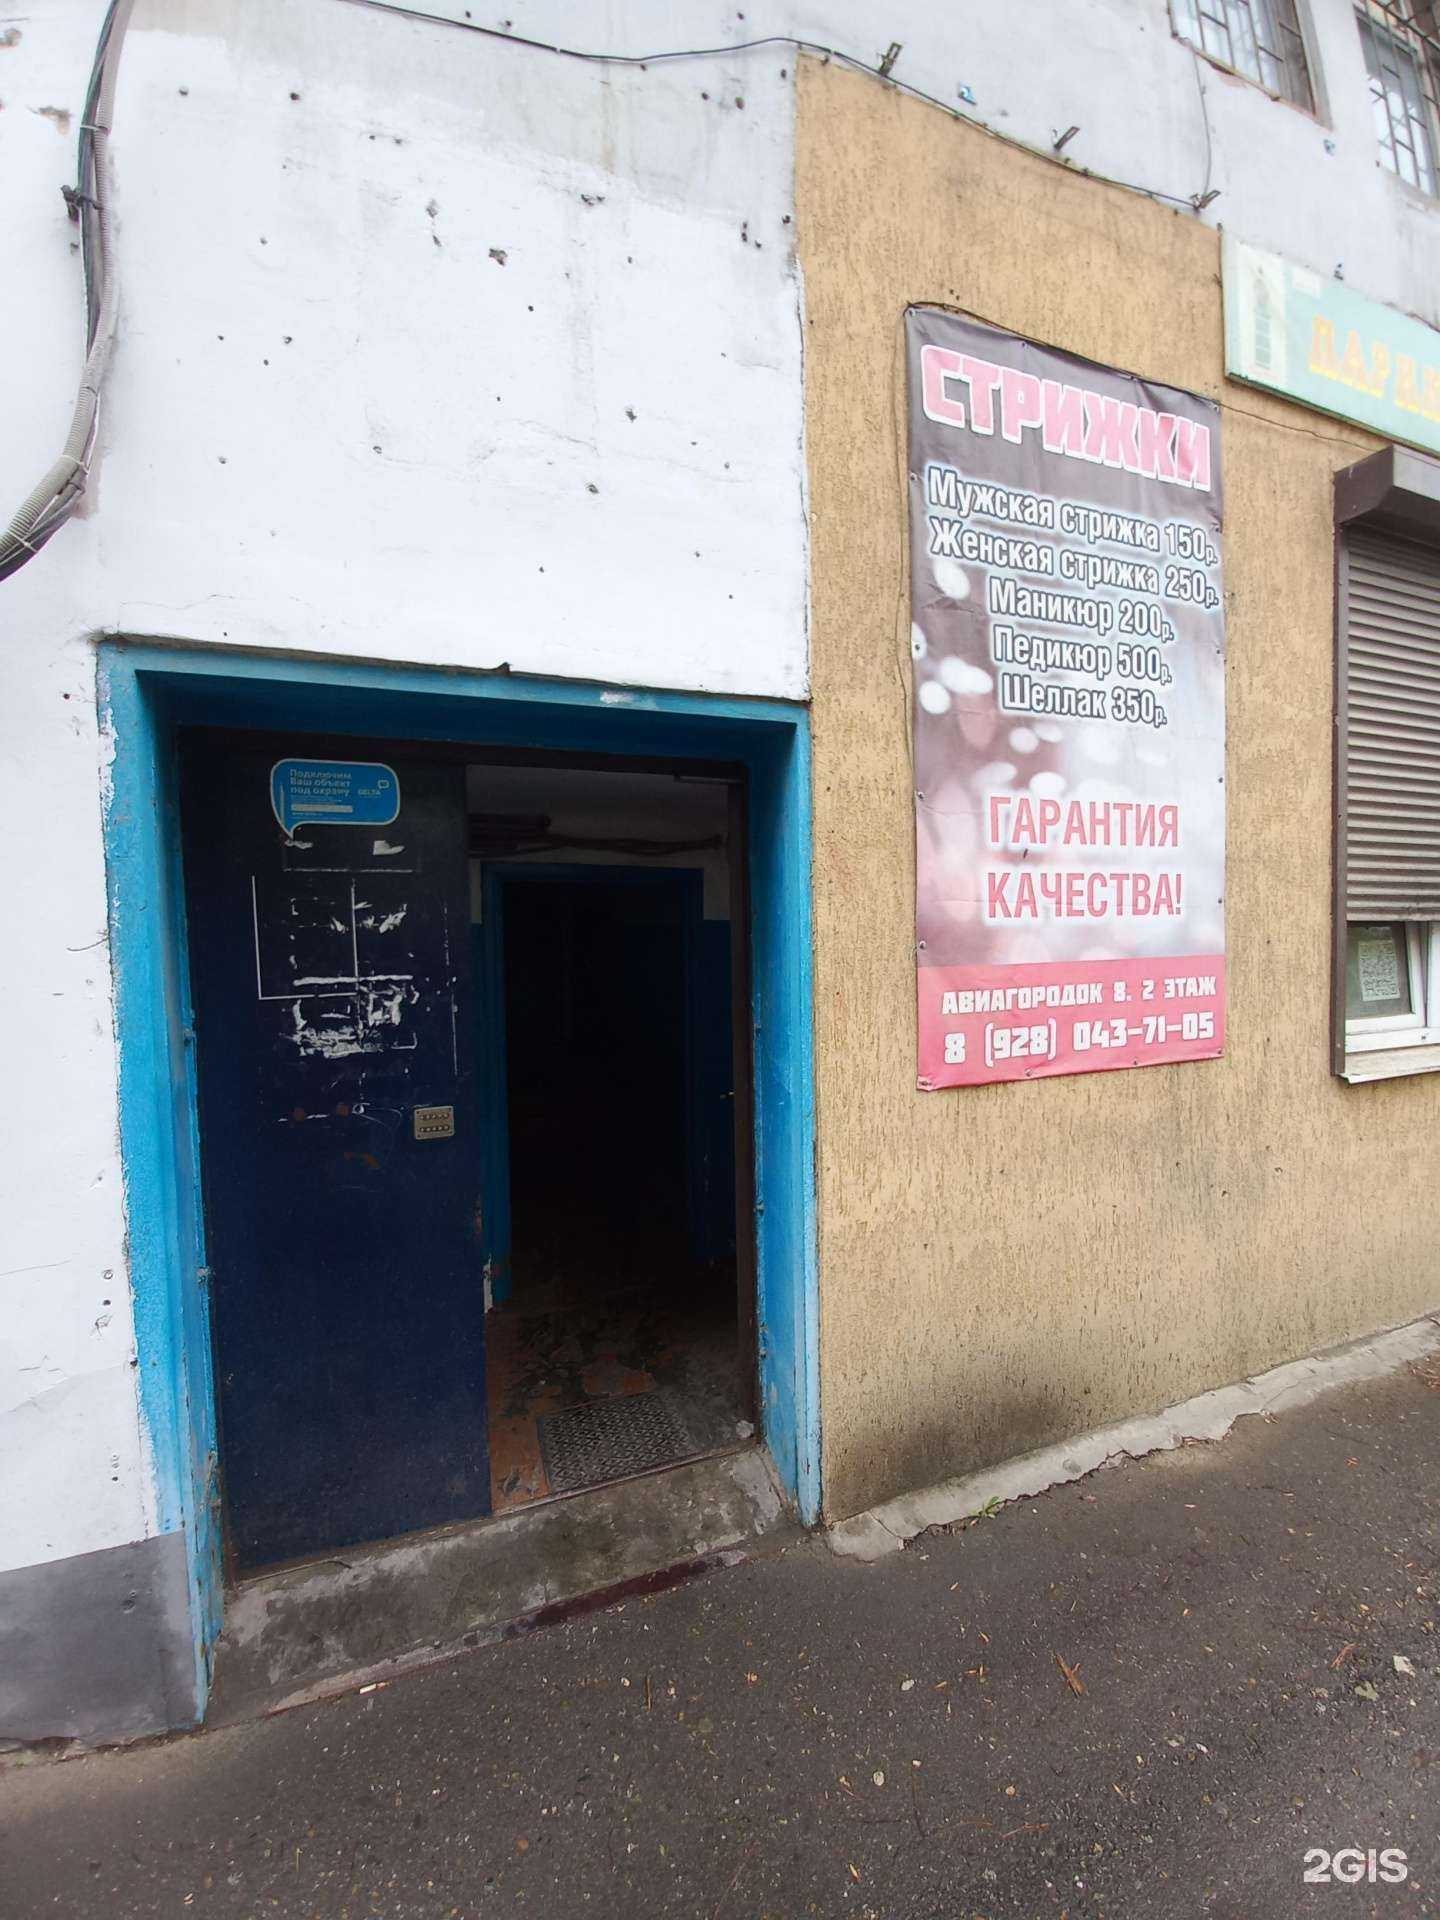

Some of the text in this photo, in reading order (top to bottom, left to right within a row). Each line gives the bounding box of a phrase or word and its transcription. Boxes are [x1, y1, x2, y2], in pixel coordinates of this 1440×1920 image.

[921, 344, 1211, 492] СТРИЖКИ
[929, 467, 1218, 565] Мужская стрижка 150р.
[930, 518, 1219, 607] Женская стрижка 250р.
[990, 577, 1173, 642] Маникюр 200р.
[994, 625, 1172, 684] Педикюр 500р.
[1002, 673, 1167, 727] Шеллак 350р.
[989, 796, 1178, 848] ГАРАНТИЯ
[987, 872, 1181, 919] КАЧЕСТВА!
[942, 983, 1103, 1015] АВИАГОРОДОК
[1142, 979, 1154, 1000] 2
[1163, 976, 1216, 999] ЭТАЖ
[944, 1011, 1214, 1068] 8 (928) 043-71-05
